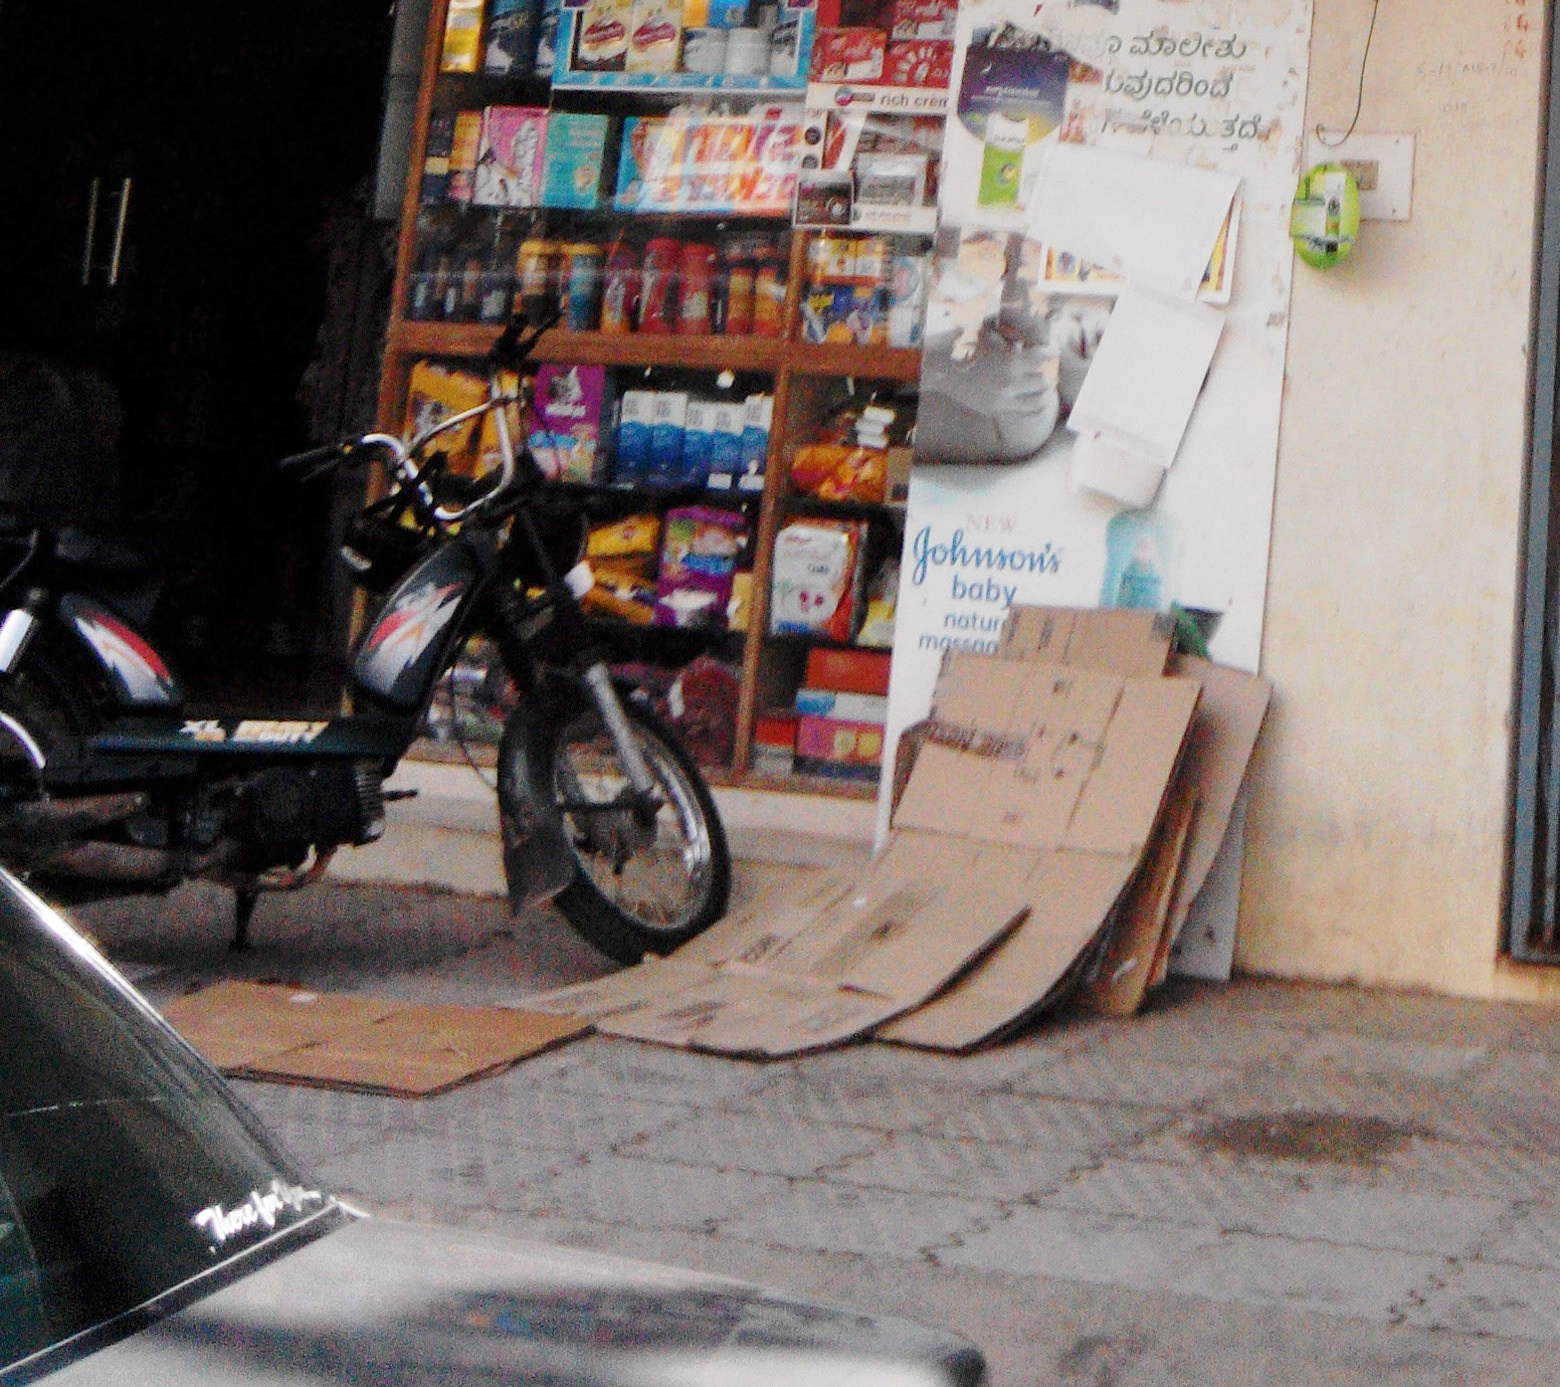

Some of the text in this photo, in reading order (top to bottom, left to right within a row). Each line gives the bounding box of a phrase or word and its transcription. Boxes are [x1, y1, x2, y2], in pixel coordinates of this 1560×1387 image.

[880, 93, 909, 107] rich
[911, 524, 1061, 587] Johnson's
[951, 573, 1018, 611] baby
